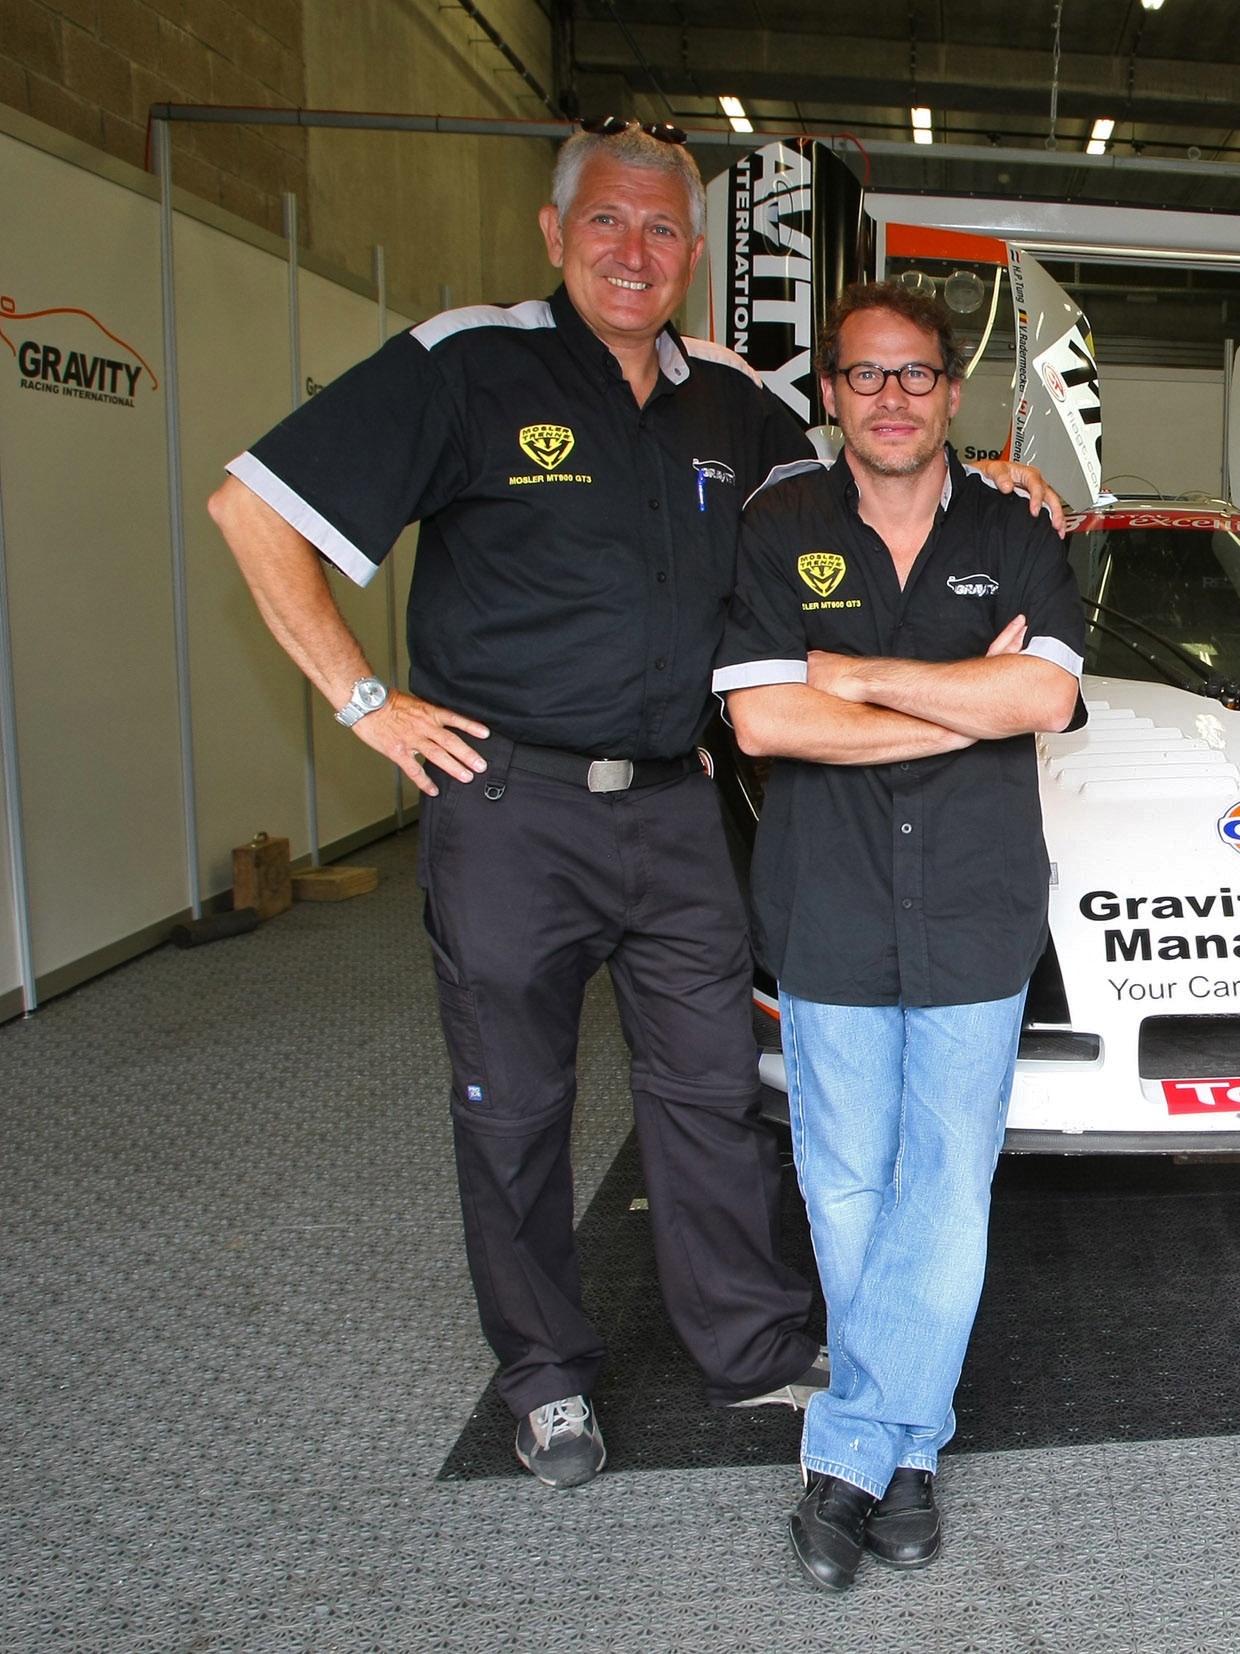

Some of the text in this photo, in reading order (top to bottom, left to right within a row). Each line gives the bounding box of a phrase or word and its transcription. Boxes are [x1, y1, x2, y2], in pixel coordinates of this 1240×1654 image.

[19, 341, 142, 397] GRAVITY
[21, 379, 135, 408] RACING INTERNATIONAL
[522, 426, 569, 435] MOSLER
[509, 474, 545, 485] MOSLER
[575, 474, 592, 483] GT3
[801, 554, 841, 563] MOSLER
[846, 600, 862, 608] GT3
[1107, 977, 1177, 1001] Your
